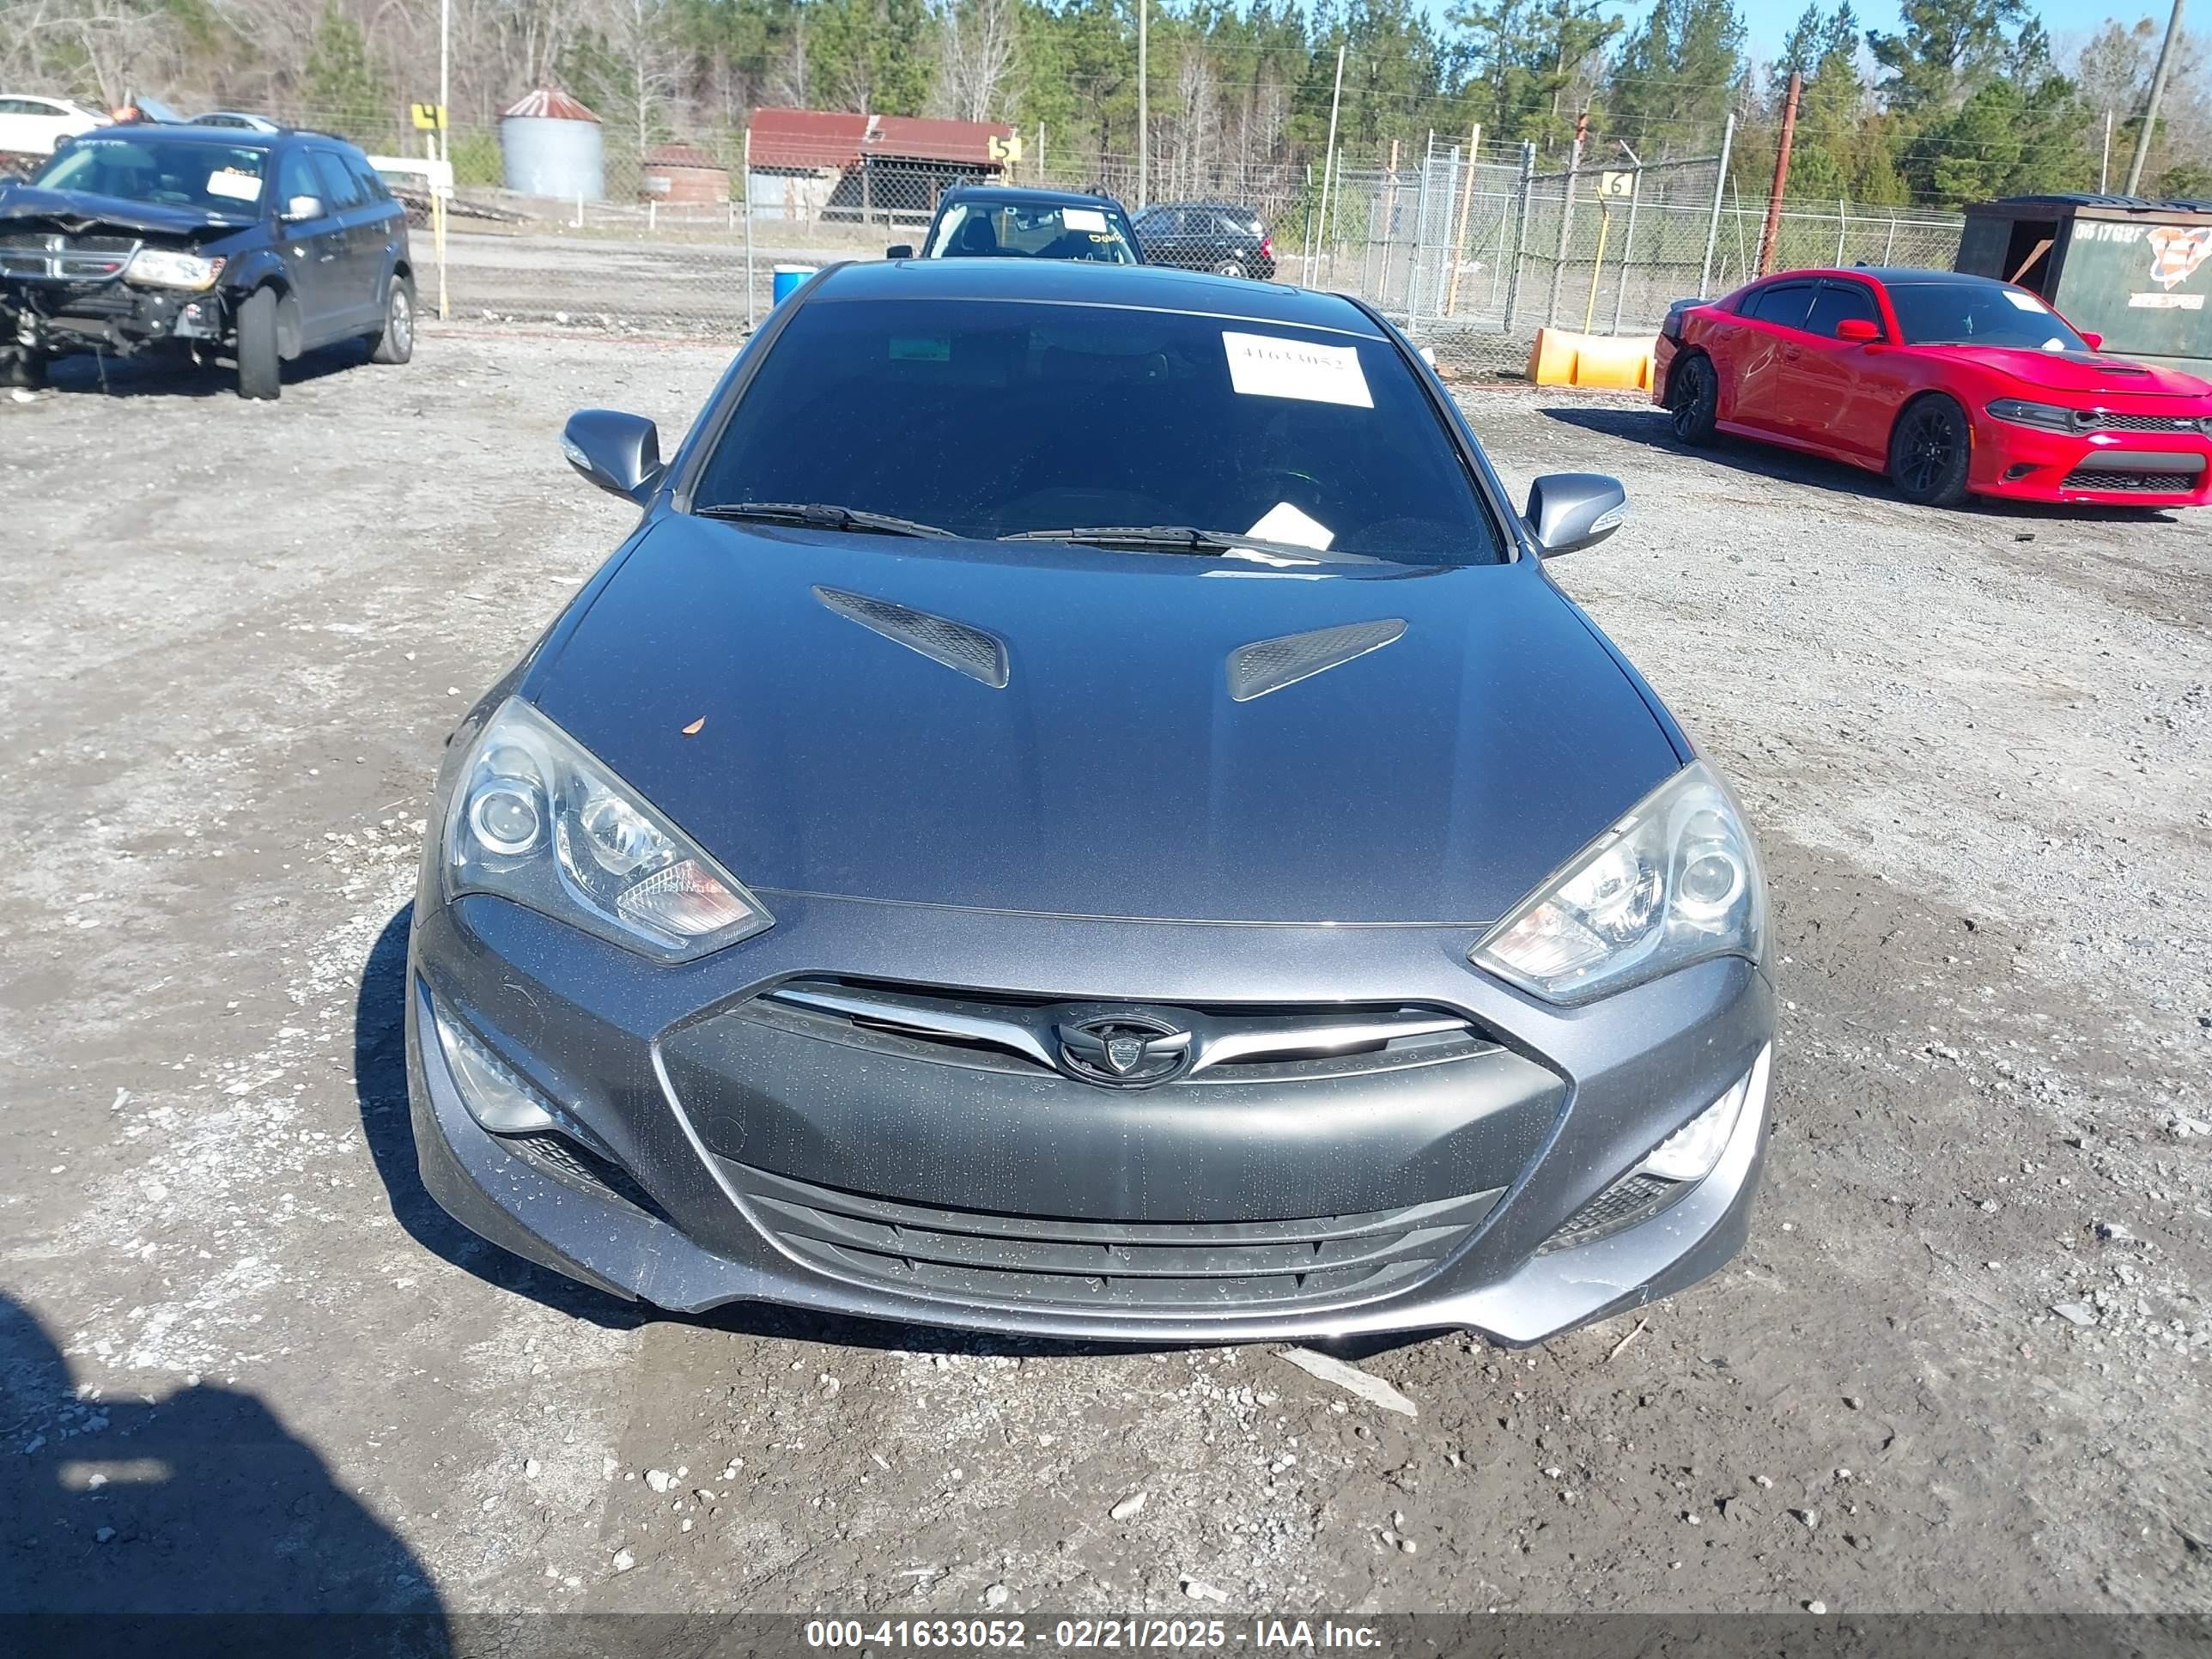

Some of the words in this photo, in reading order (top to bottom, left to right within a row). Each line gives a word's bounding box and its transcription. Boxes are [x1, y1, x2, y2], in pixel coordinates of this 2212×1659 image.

[419, 102, 439, 127] 4
[995, 137, 1010, 159] 5
[1611, 173, 1626, 194] 6
